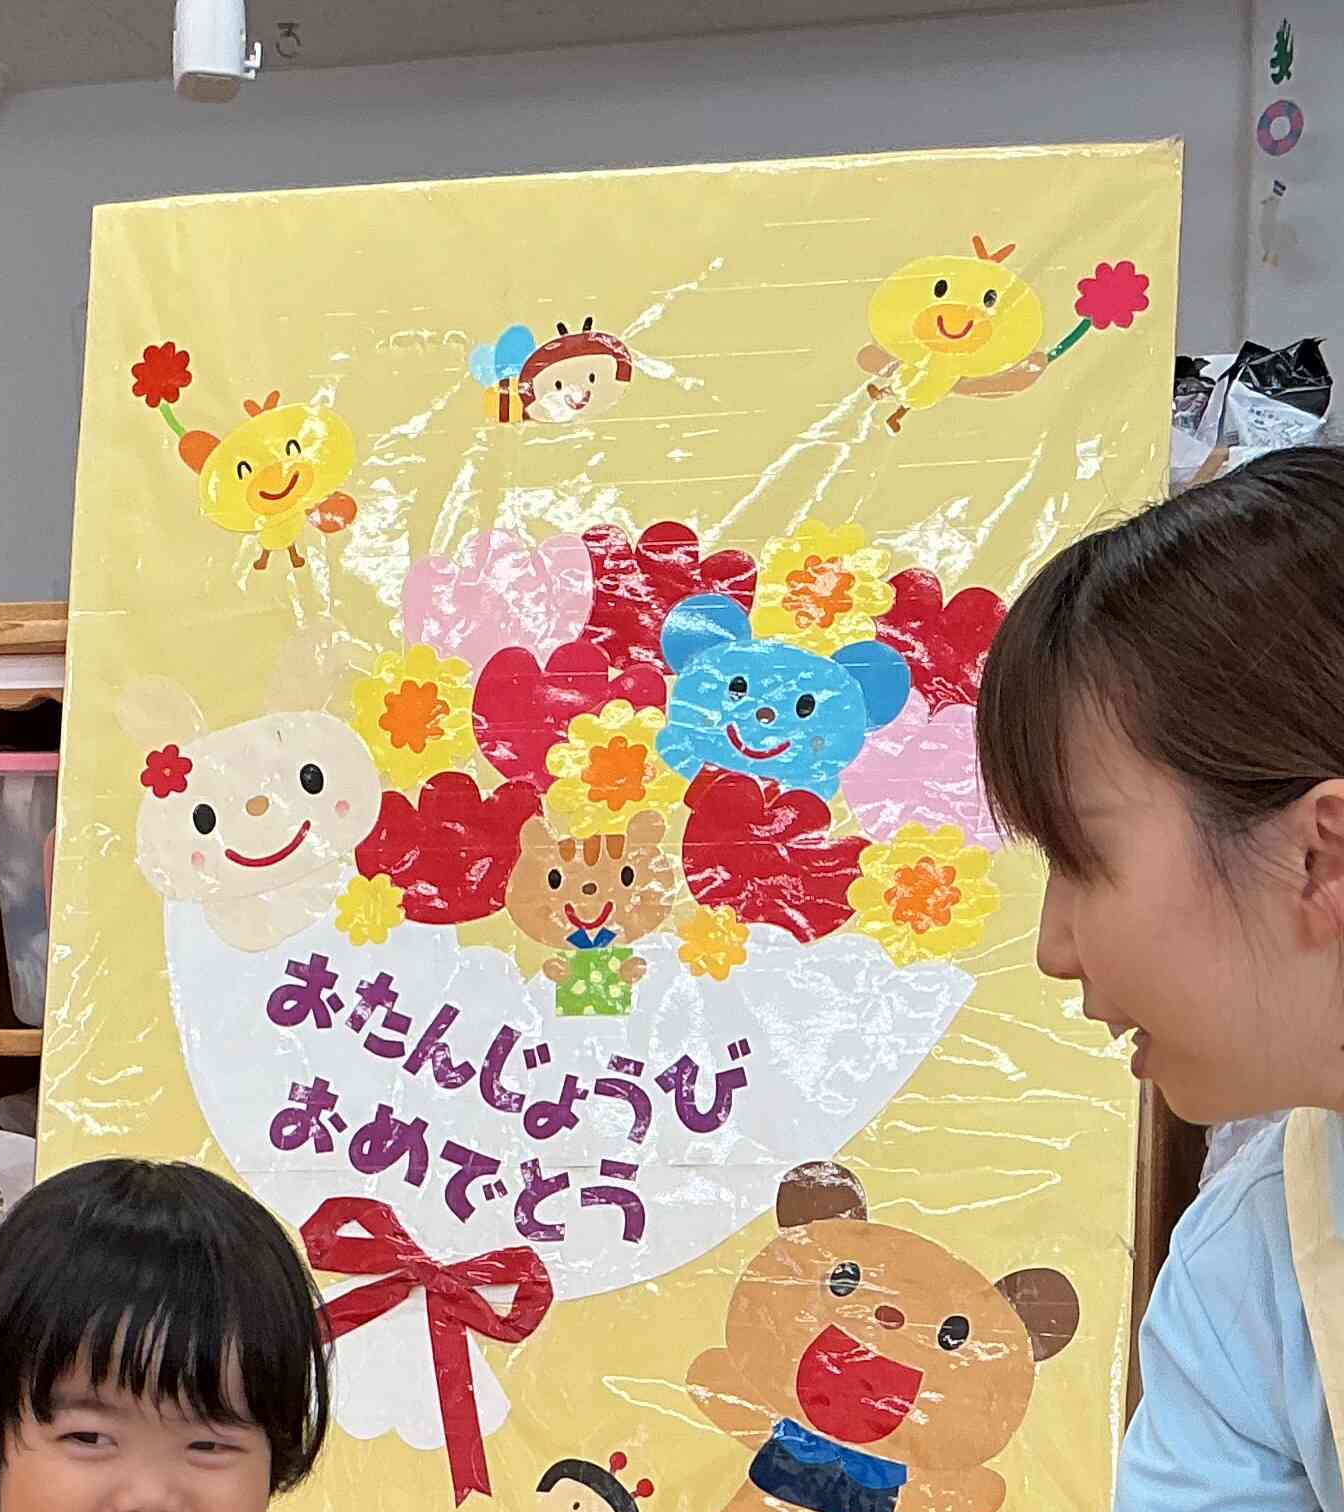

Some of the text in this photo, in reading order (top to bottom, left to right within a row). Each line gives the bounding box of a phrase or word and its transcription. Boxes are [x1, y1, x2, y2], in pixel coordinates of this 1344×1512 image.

[266, 952, 752, 1144] おたんじょうび
[269, 1077, 646, 1243] おめでとう
